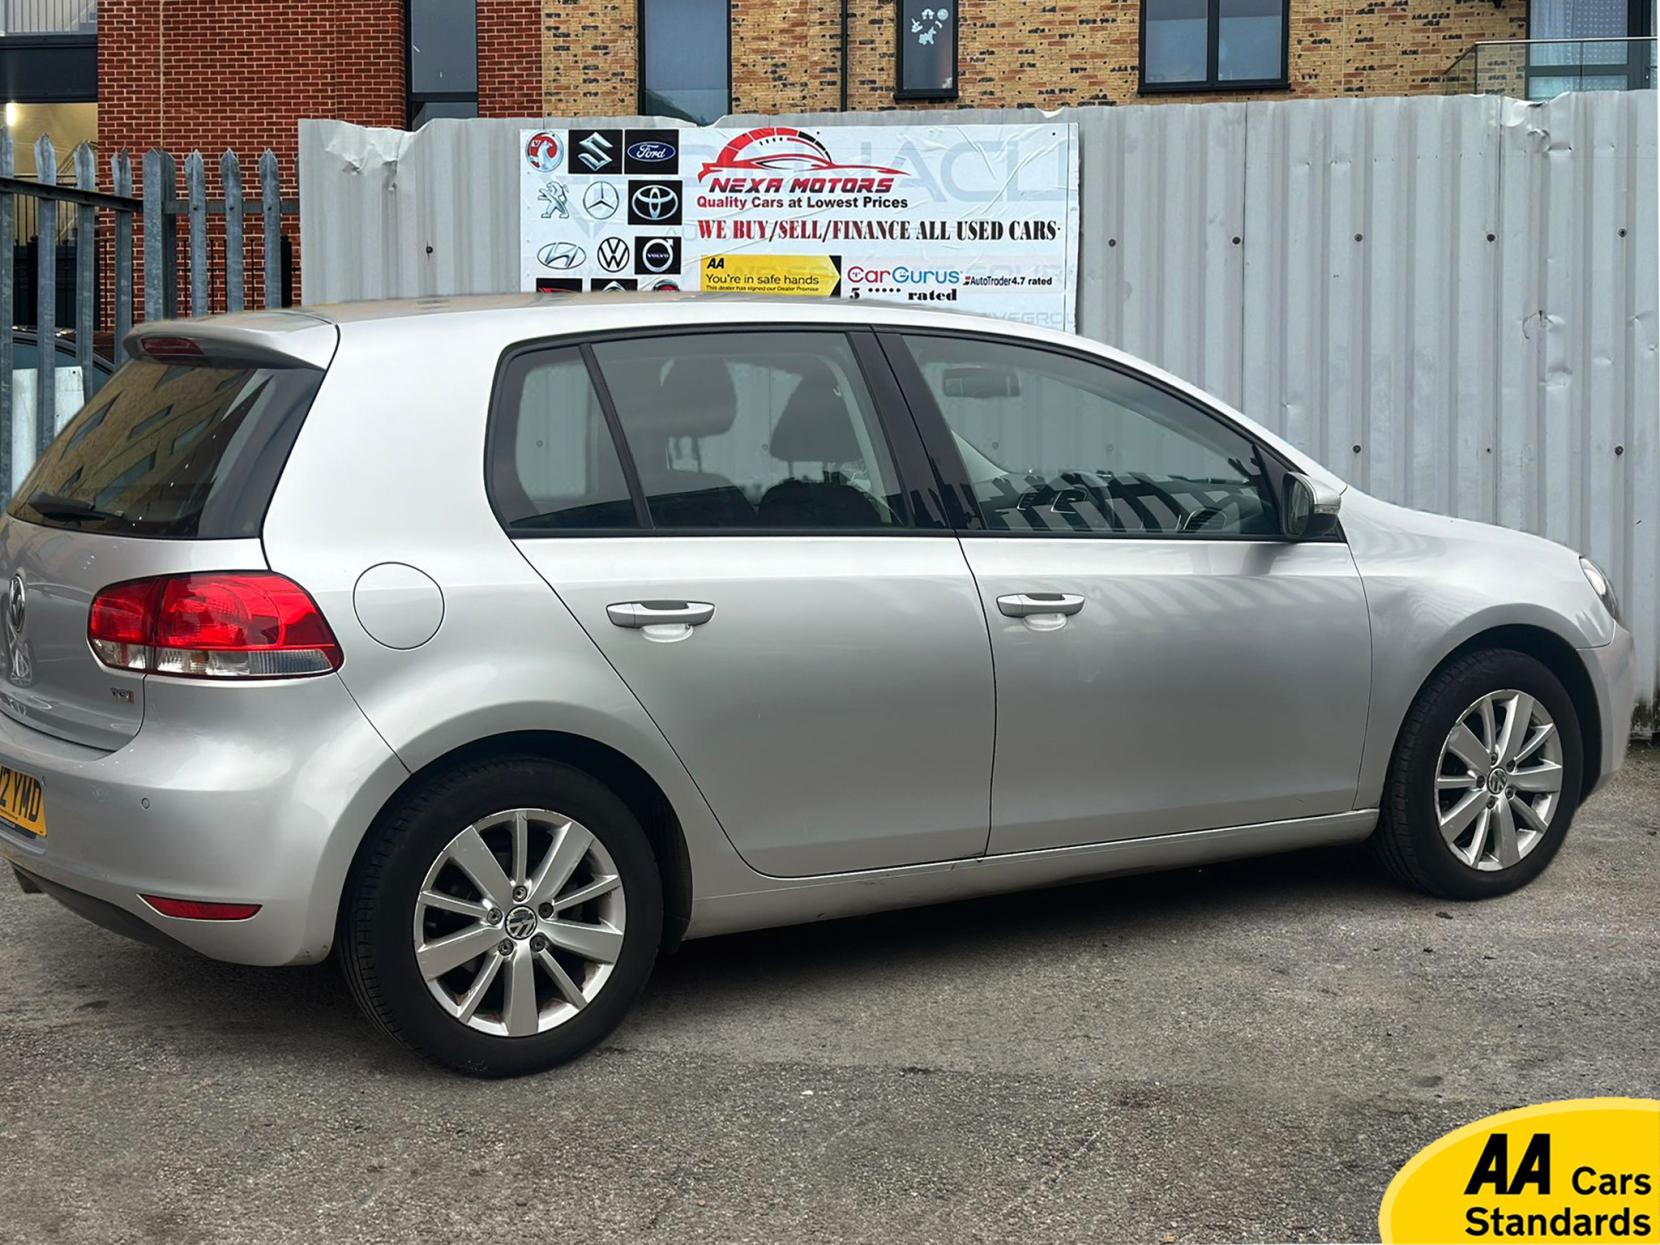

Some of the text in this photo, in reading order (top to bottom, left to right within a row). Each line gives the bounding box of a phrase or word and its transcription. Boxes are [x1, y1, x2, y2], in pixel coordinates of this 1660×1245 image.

[636, 143, 666, 159] Ford
[708, 178, 895, 194] NEXA MOTORS
[697, 196, 909, 211] Quality Cars at Lowest Prices
[697, 219, 727, 240] WE
[916, 220, 951, 241] ALL
[956, 220, 1004, 241] USED
[1009, 220, 1057, 241] CARS
[706, 257, 725, 270] AA
[706, 274, 820, 285] You're in safe hands
[847, 266, 960, 284] CarGurus
[1028, 276, 1053, 286] rated
[908, 288, 957, 301] rated
